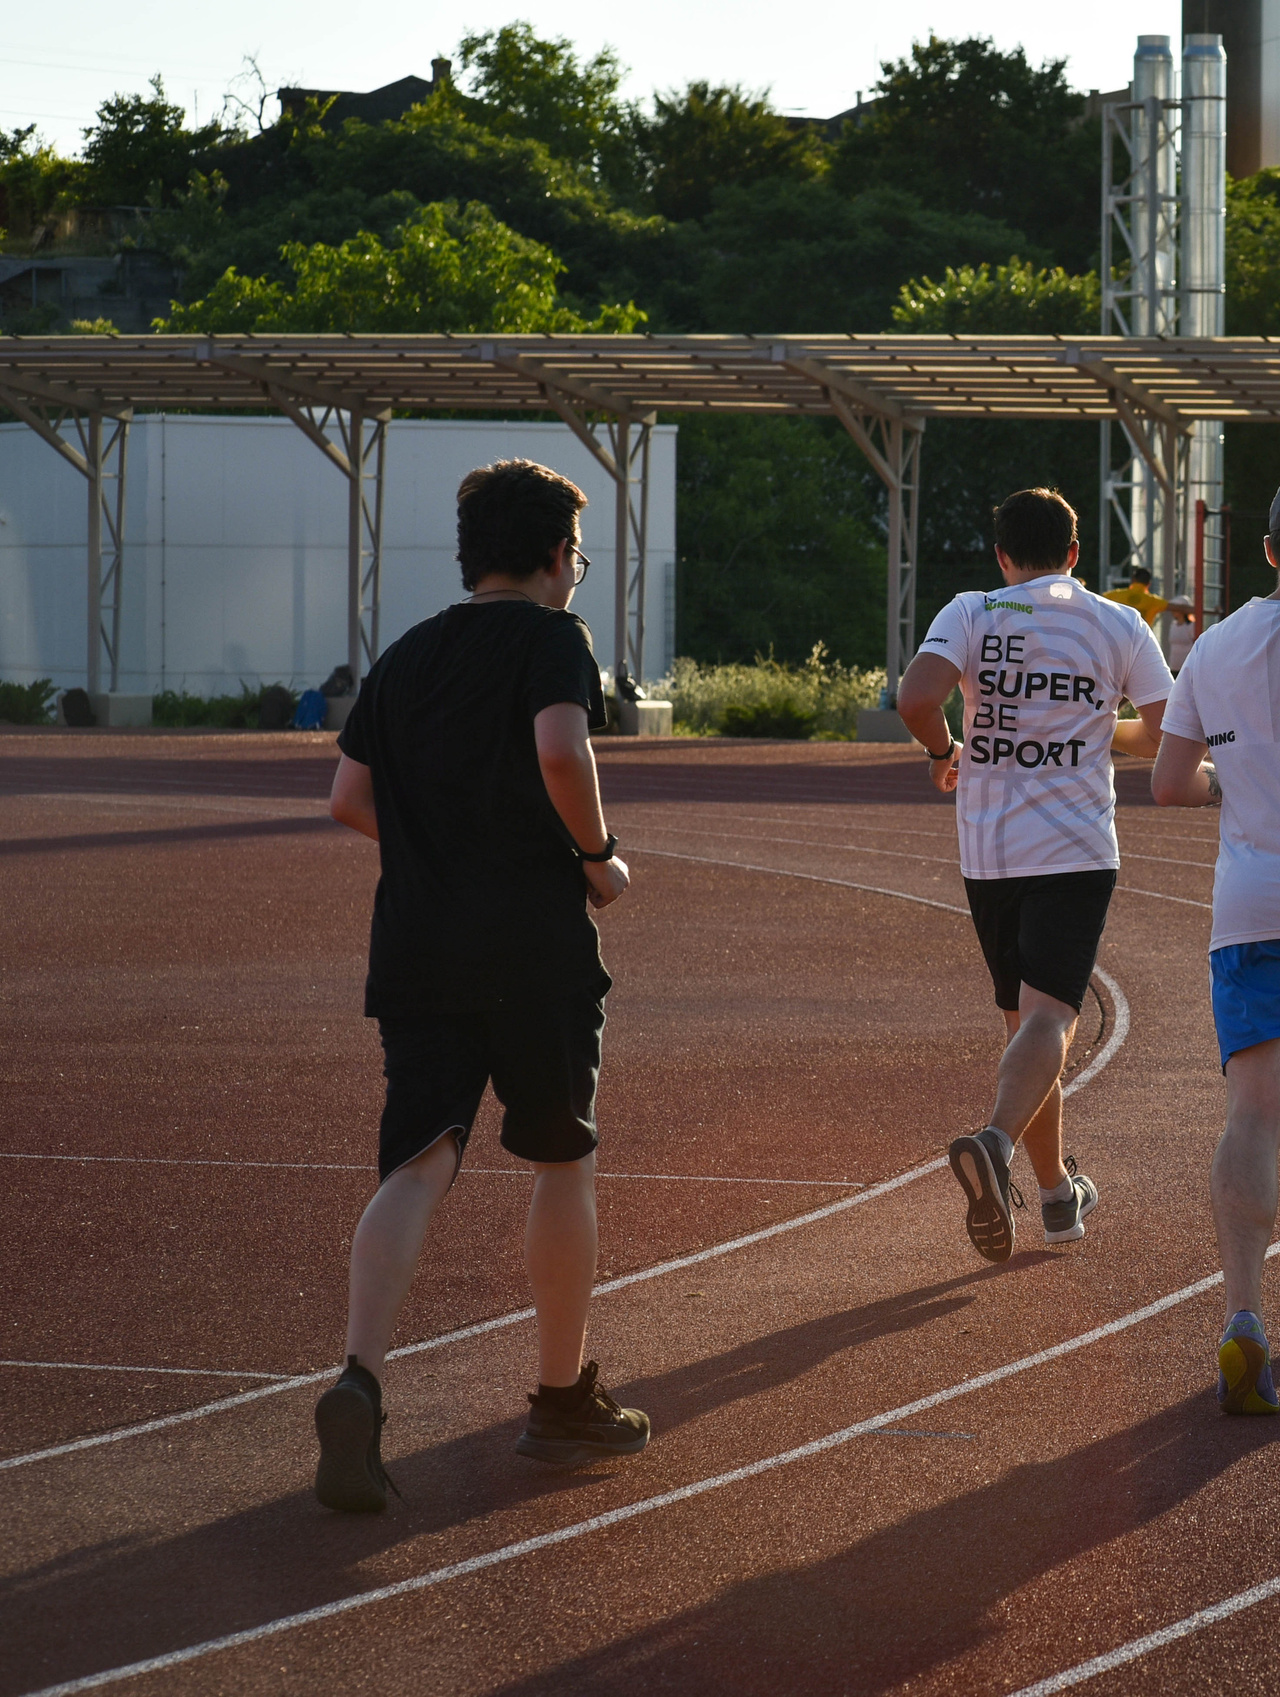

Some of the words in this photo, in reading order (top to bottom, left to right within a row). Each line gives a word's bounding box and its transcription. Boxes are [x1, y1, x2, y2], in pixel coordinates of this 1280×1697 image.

[980, 634, 1026, 664] BE
[978, 669, 1105, 711] SUPER,
[973, 702, 1019, 732] BE
[970, 735, 1086, 769] SPORT
[1206, 730, 1236, 748] NING
